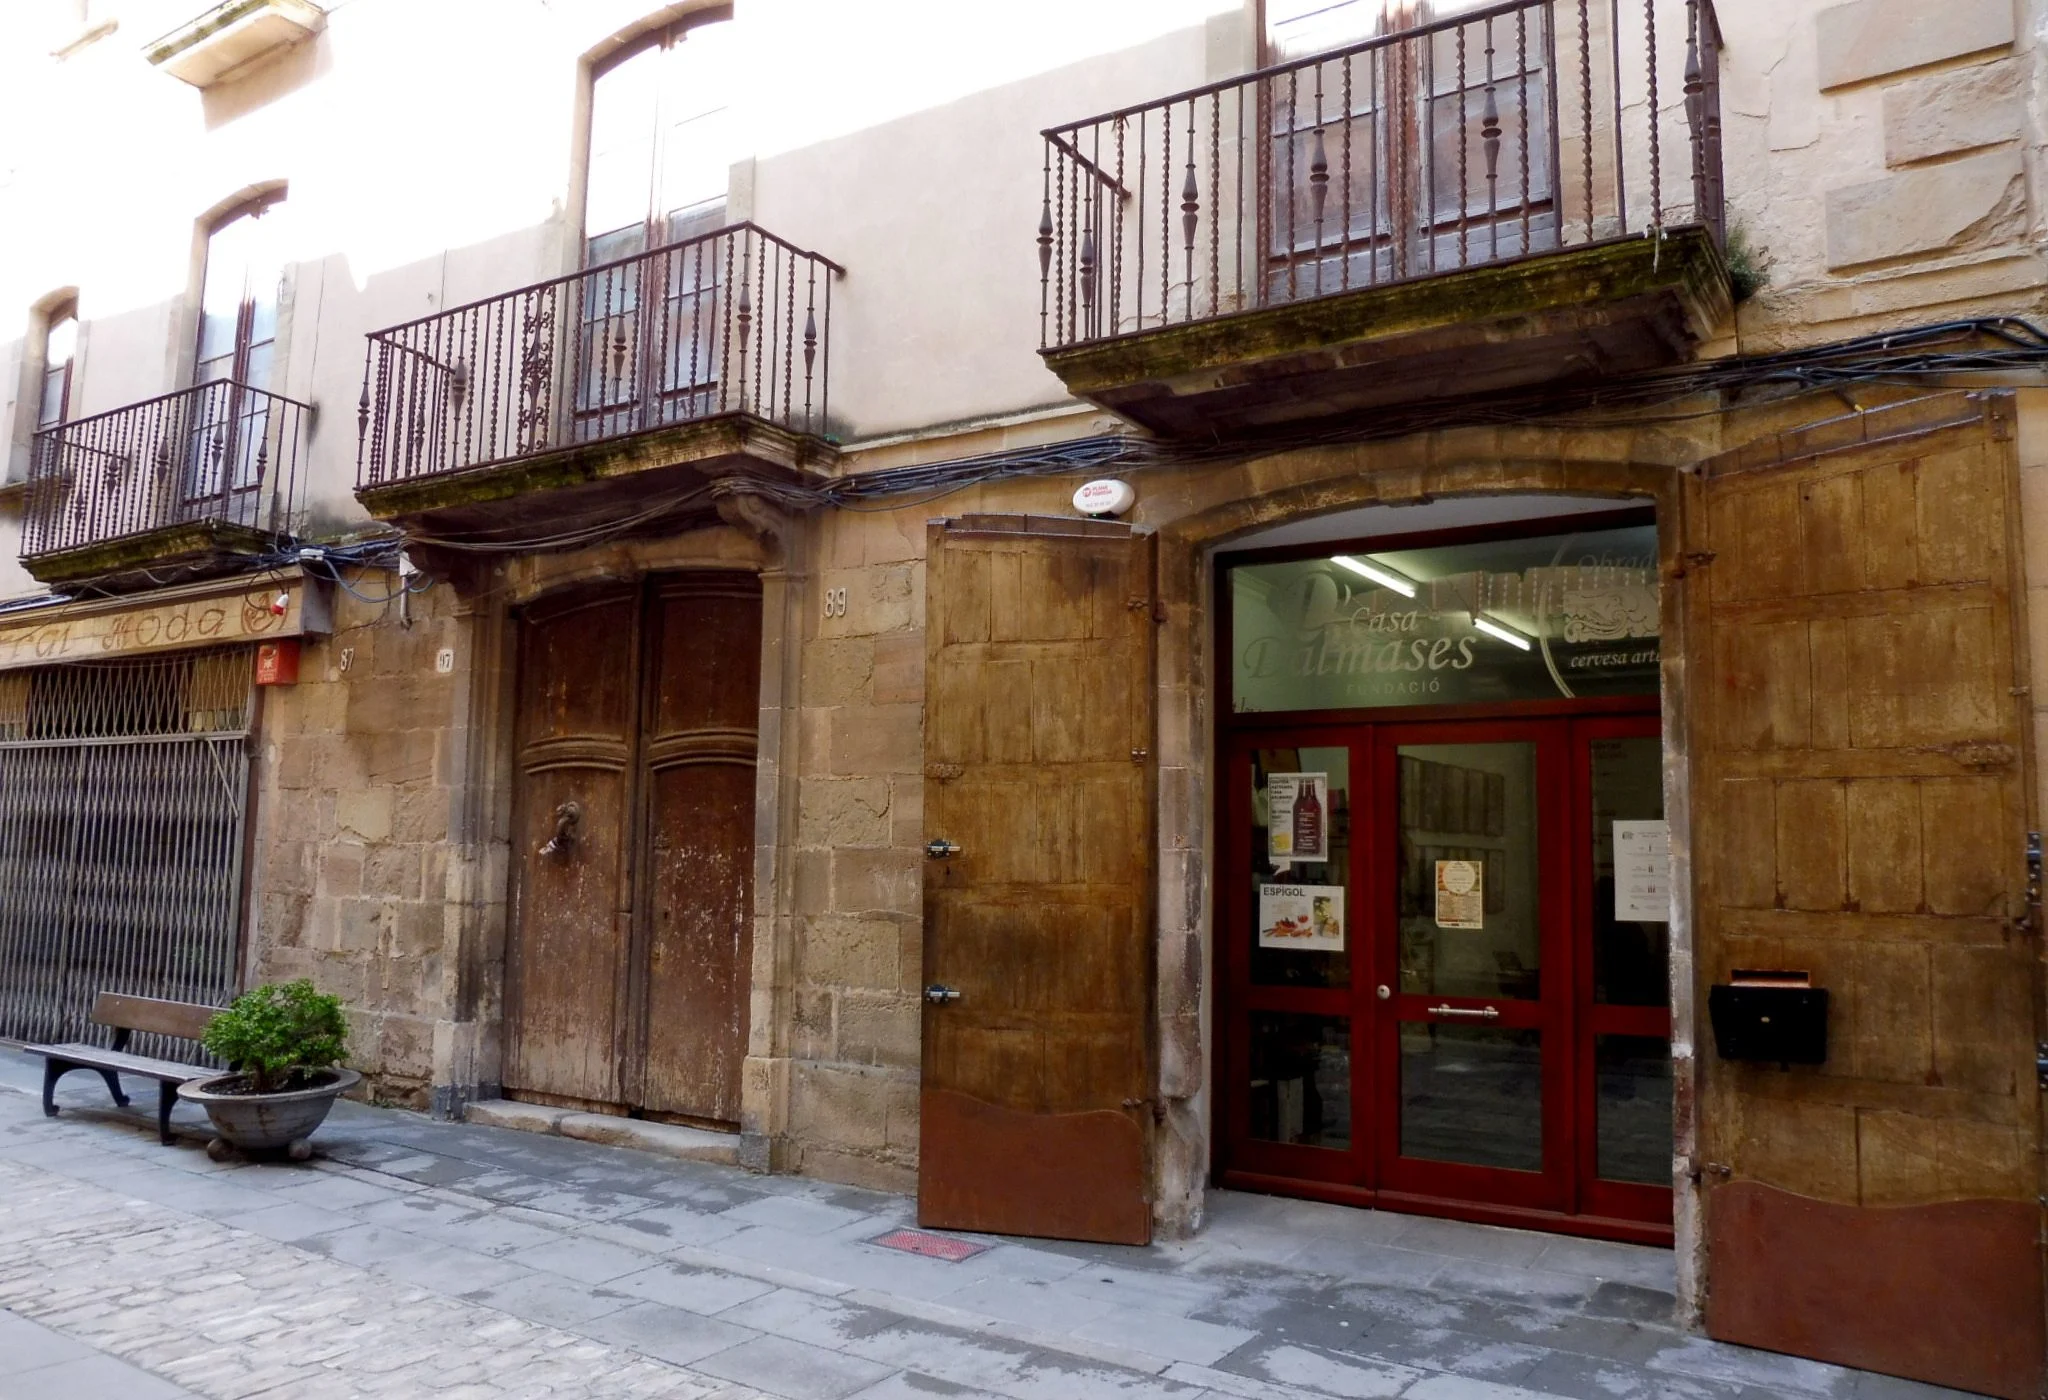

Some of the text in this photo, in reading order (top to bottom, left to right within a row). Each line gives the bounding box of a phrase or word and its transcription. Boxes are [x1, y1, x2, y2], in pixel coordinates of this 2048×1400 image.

[825, 587, 847, 618] 89
[1351, 607, 1418, 633] Casa
[339, 647, 354, 672] 87
[1242, 629, 1477, 679] Dalmases
[1570, 652, 1627, 668] cervesa
[1345, 677, 1440, 696] FUNDACIÓ
